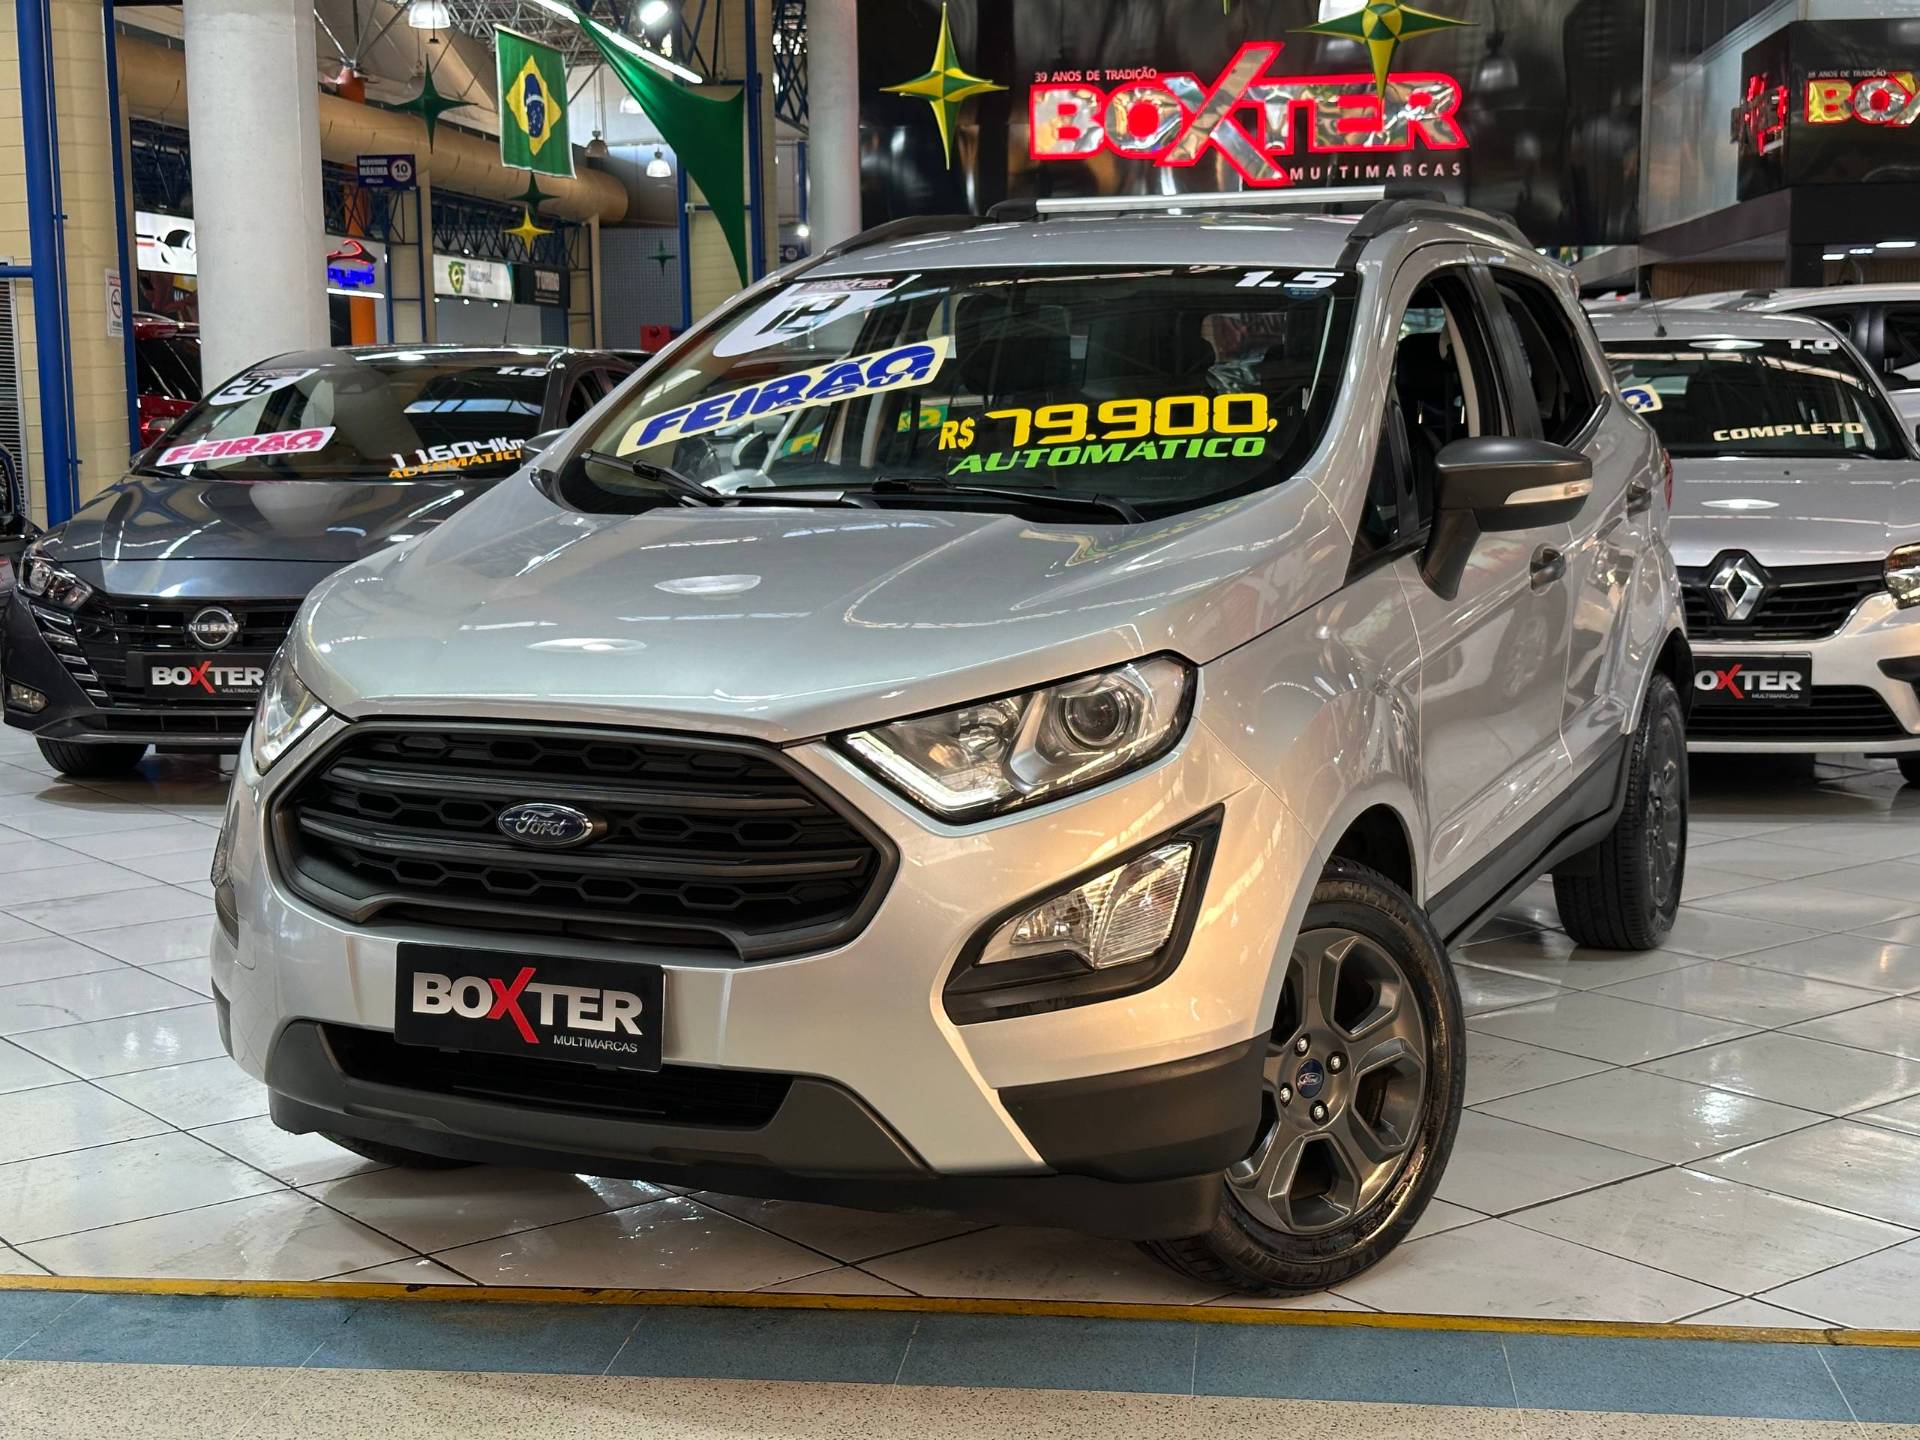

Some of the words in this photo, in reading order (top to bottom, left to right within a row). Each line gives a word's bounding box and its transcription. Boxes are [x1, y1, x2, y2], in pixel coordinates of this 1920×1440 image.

[1034, 72, 1048, 82] 39
[1051, 70, 1082, 82] ANOS
[1086, 70, 1100, 81] DE
[1105, 66, 1157, 82] TRADIÇÃO
[1030, 42, 1468, 186] BOXTER
[394, 163, 408, 173] 10
[1235, 270, 1345, 289] 1.5
[1788, 340, 1839, 350] 1.0
[938, 417, 975, 452] R$
[984, 393, 1279, 447] 79.900,
[1713, 422, 1863, 442] COMPLETO
[188, 624, 238, 633] NISSAN
[152, 660, 265, 694] BOXTER
[515, 809, 571, 836] Ford
[412, 966, 643, 1045] BOXTER
[553, 1034, 638, 1053] MULTIMARCAS
